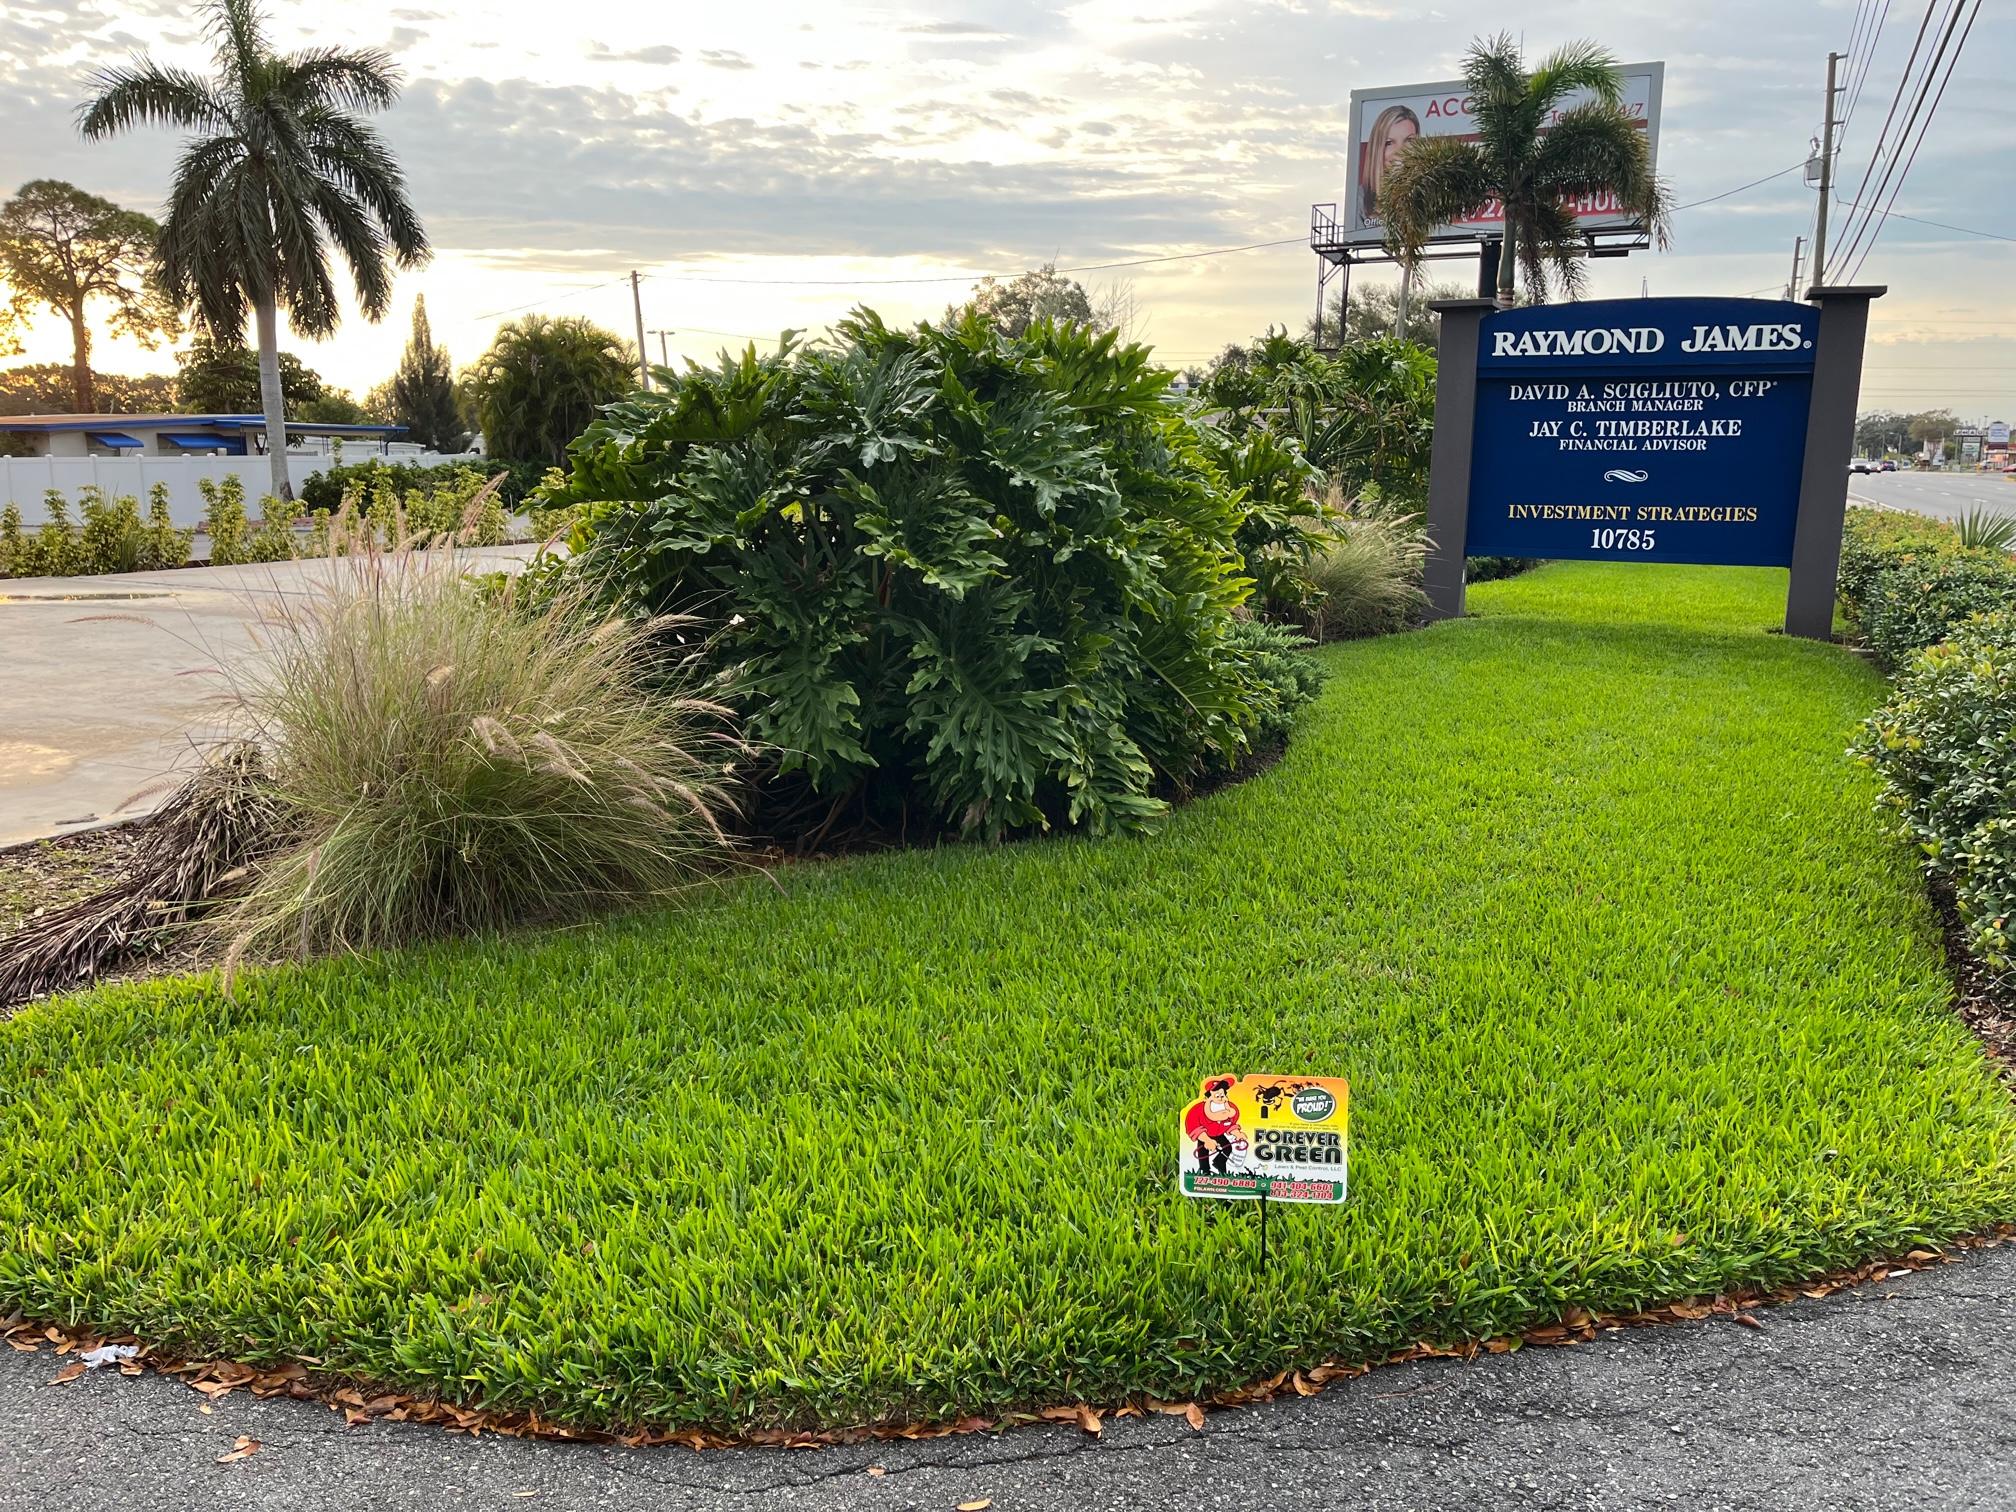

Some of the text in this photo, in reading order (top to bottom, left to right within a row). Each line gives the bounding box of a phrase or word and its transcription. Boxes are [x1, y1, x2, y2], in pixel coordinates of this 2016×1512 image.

[1426, 98, 1474, 118] ACC
[1364, 218, 1385, 227] Offic
[1492, 328, 1665, 356] RAYMOND
[1509, 385, 1569, 401] DAVID
[1576, 384, 1596, 400] A.
[1603, 382, 1720, 401] SCIGLIUTO,
[1567, 400, 1704, 413] BRANCH MANAGER
[1529, 420, 1742, 438] JAY C. TIMBERLAKE
[1559, 439, 1707, 451] FINANCIAL ADVISOR
[1508, 505, 1758, 521] INVESTMENT STRATEGIES
[1590, 529, 1656, 551] 10785
[1254, 1129, 1341, 1147] FOREVER
[1254, 1145, 1343, 1165] GREEN
